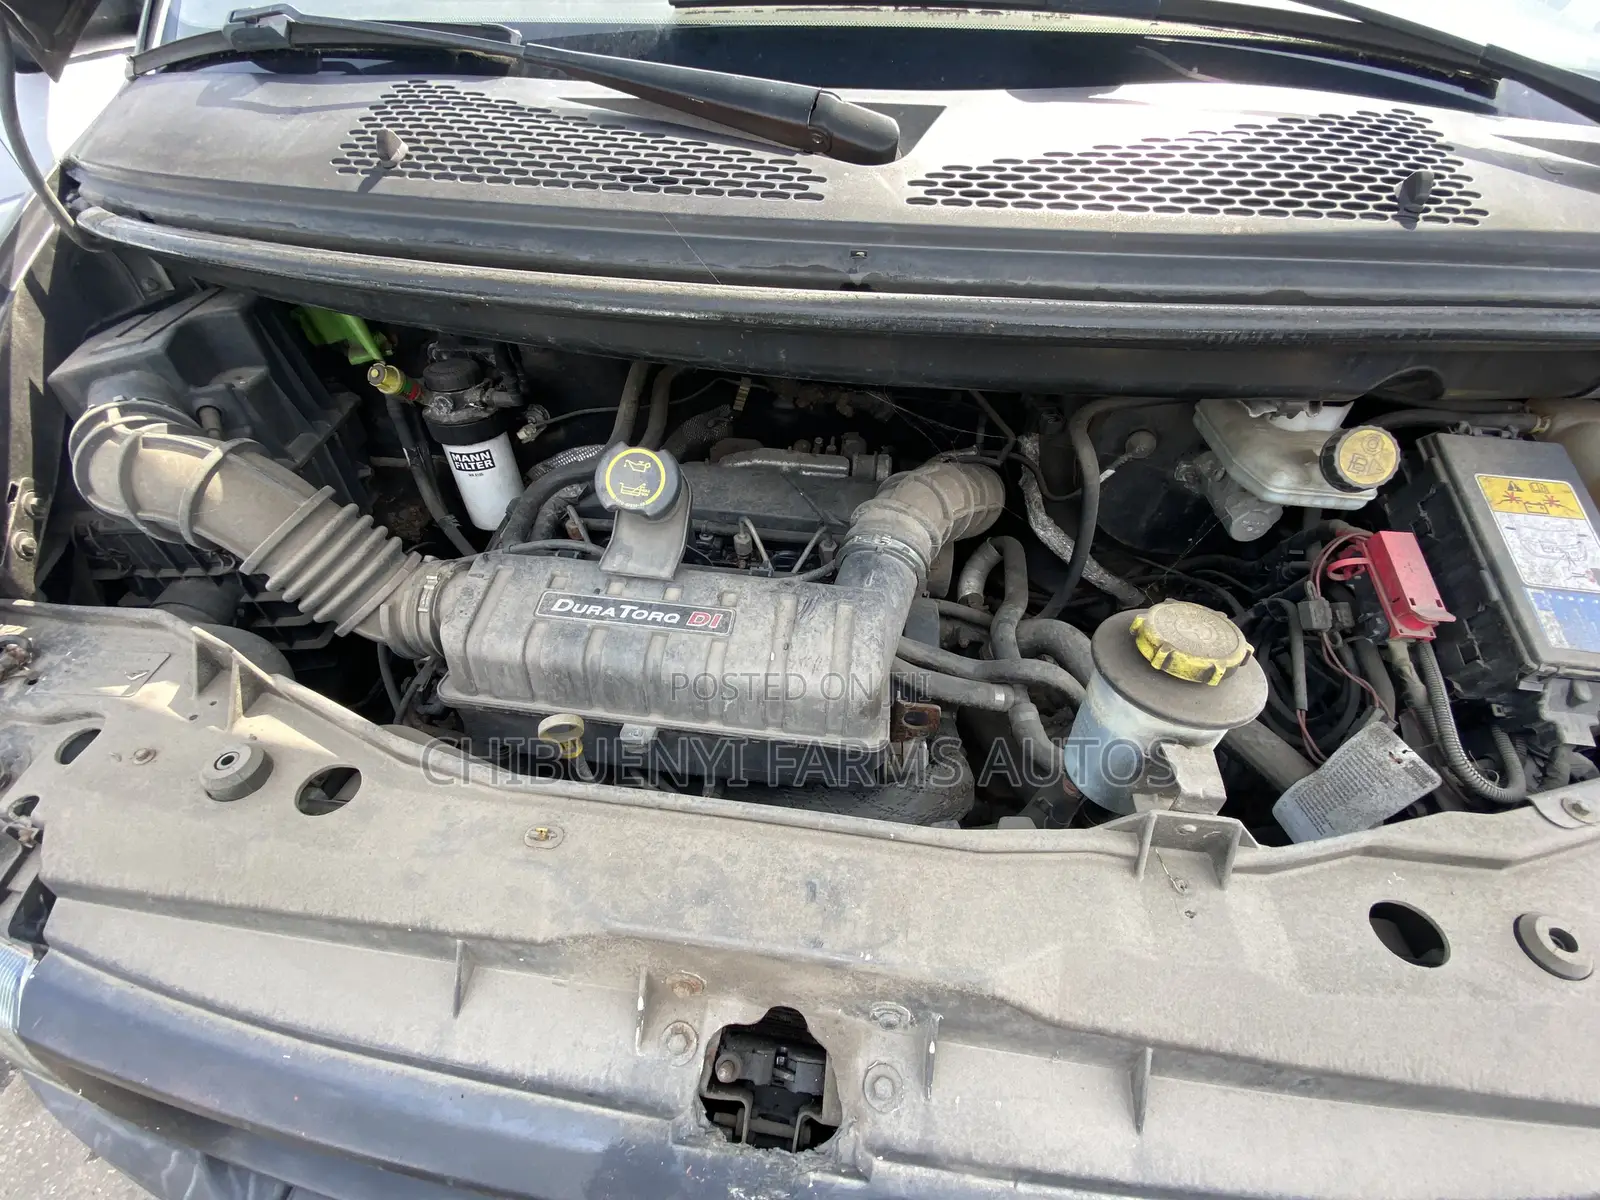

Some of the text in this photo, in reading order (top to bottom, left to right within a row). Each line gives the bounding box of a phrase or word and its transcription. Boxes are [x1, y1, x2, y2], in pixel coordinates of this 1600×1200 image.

[451, 451, 491, 462] MANN
[454, 459, 494, 470] FILTER
[686, 611, 724, 628] DI
